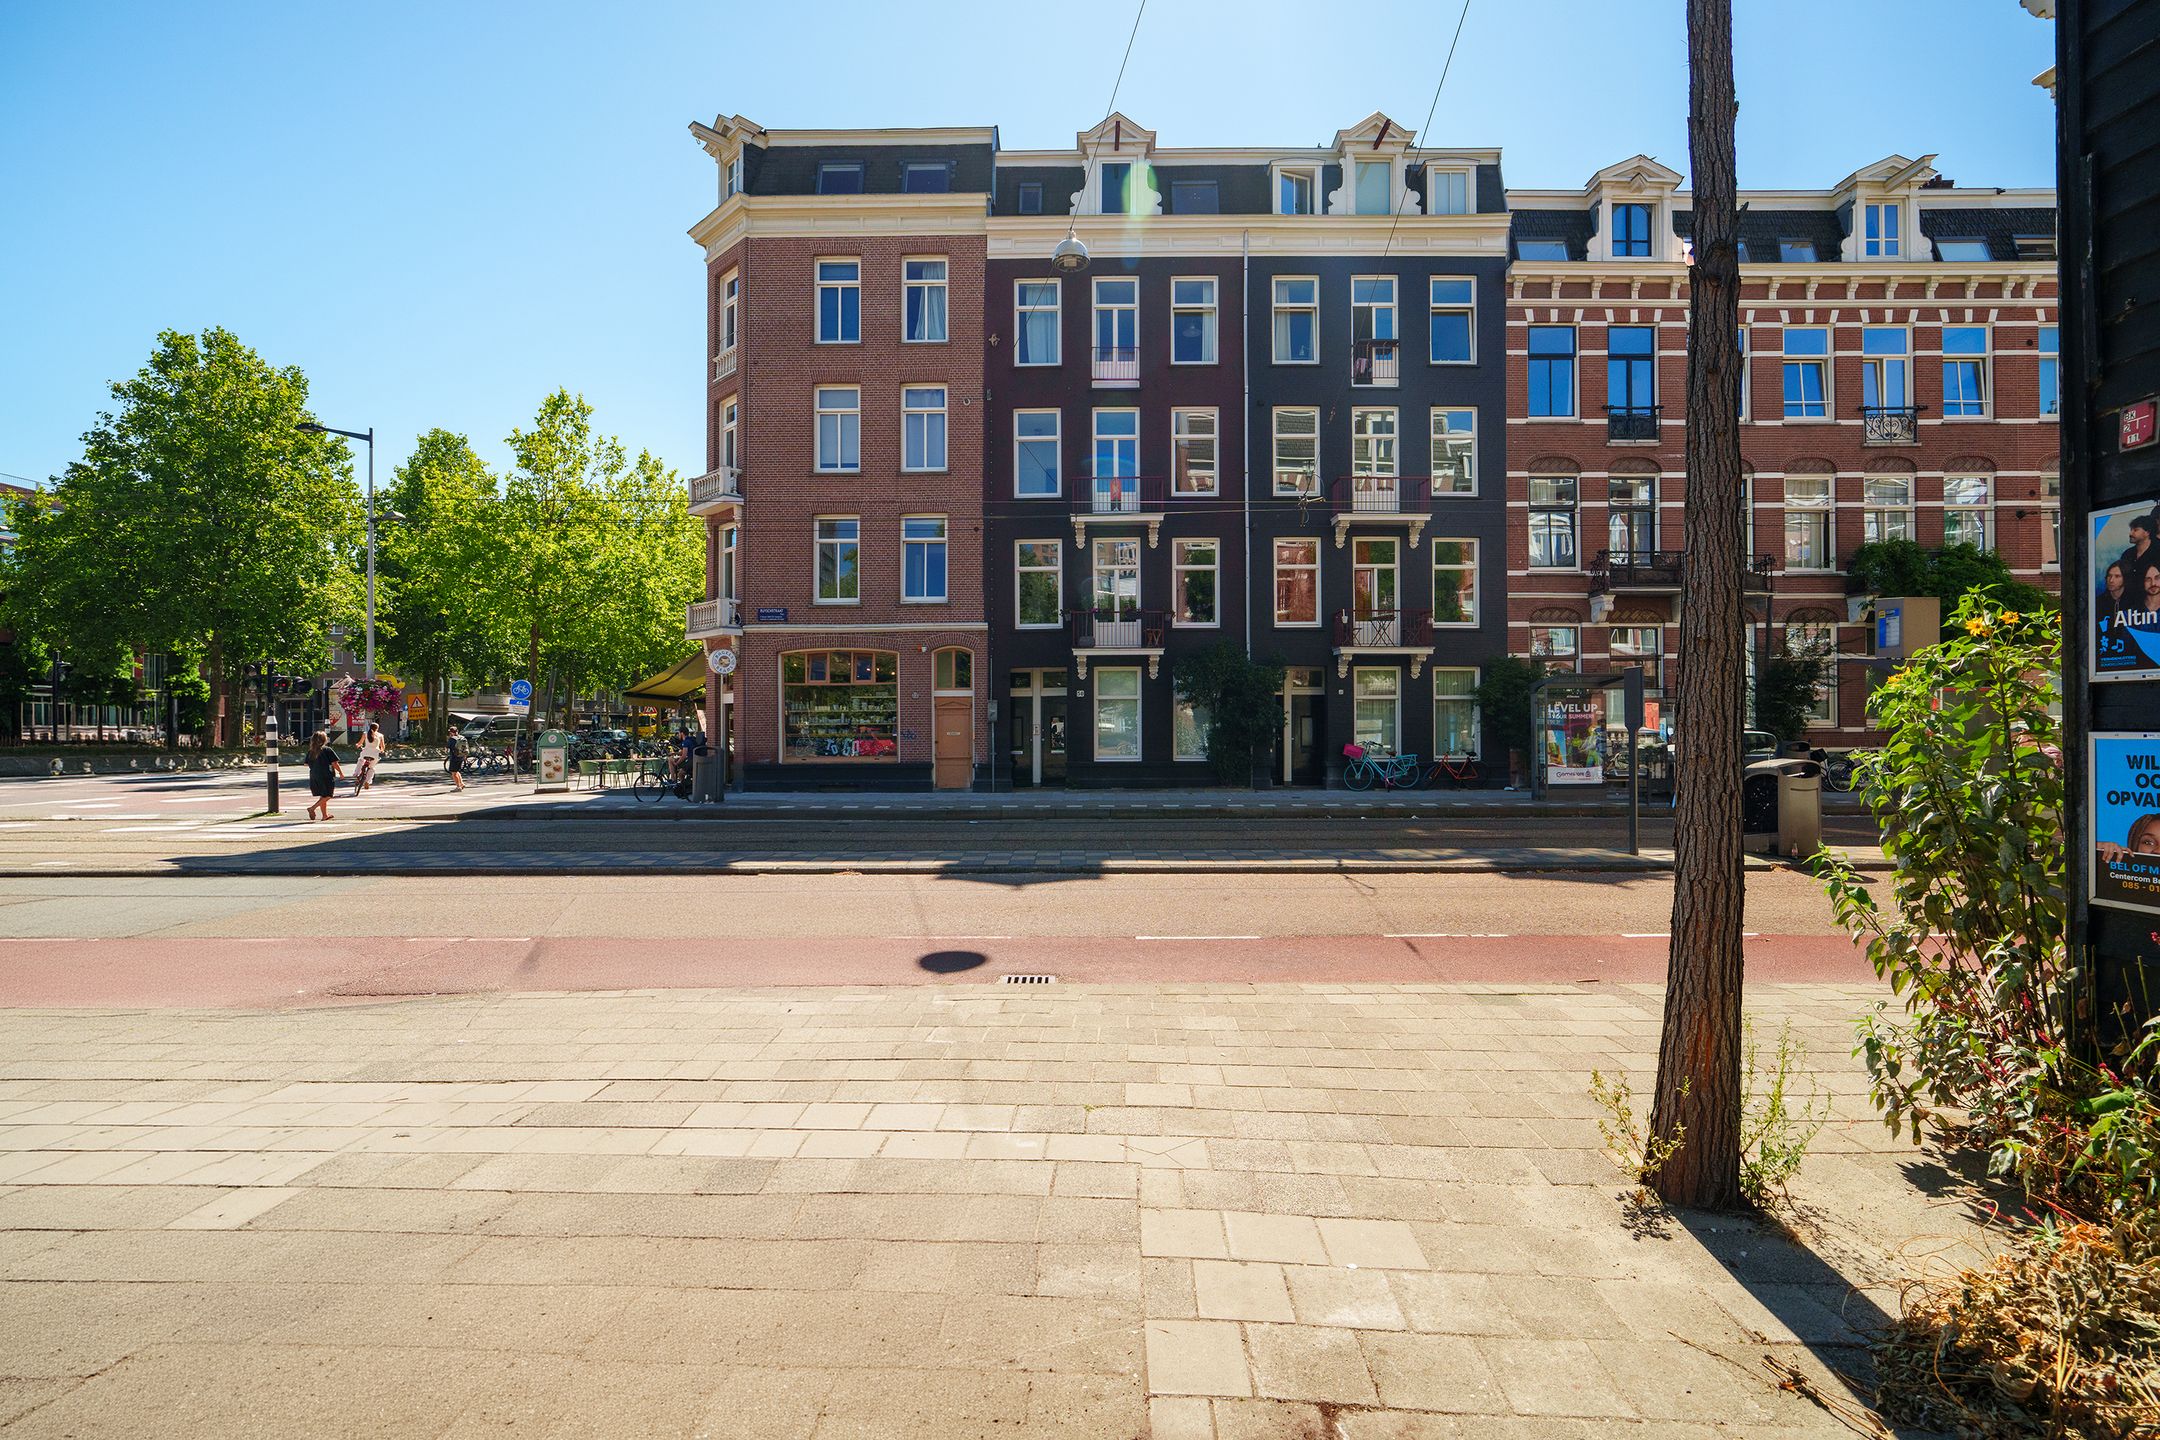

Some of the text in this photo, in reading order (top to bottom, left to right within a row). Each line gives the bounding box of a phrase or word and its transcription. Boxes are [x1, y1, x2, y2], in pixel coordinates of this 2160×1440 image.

[1547, 703, 1598, 713] LEVEL UP
[2106, 790, 2160, 808] OPVA
[2110, 861, 2130, 871] BEL
[2132, 864, 2147, 873] OF
[2109, 871, 2151, 883] Centercom
[2122, 881, 2140, 890] 085
